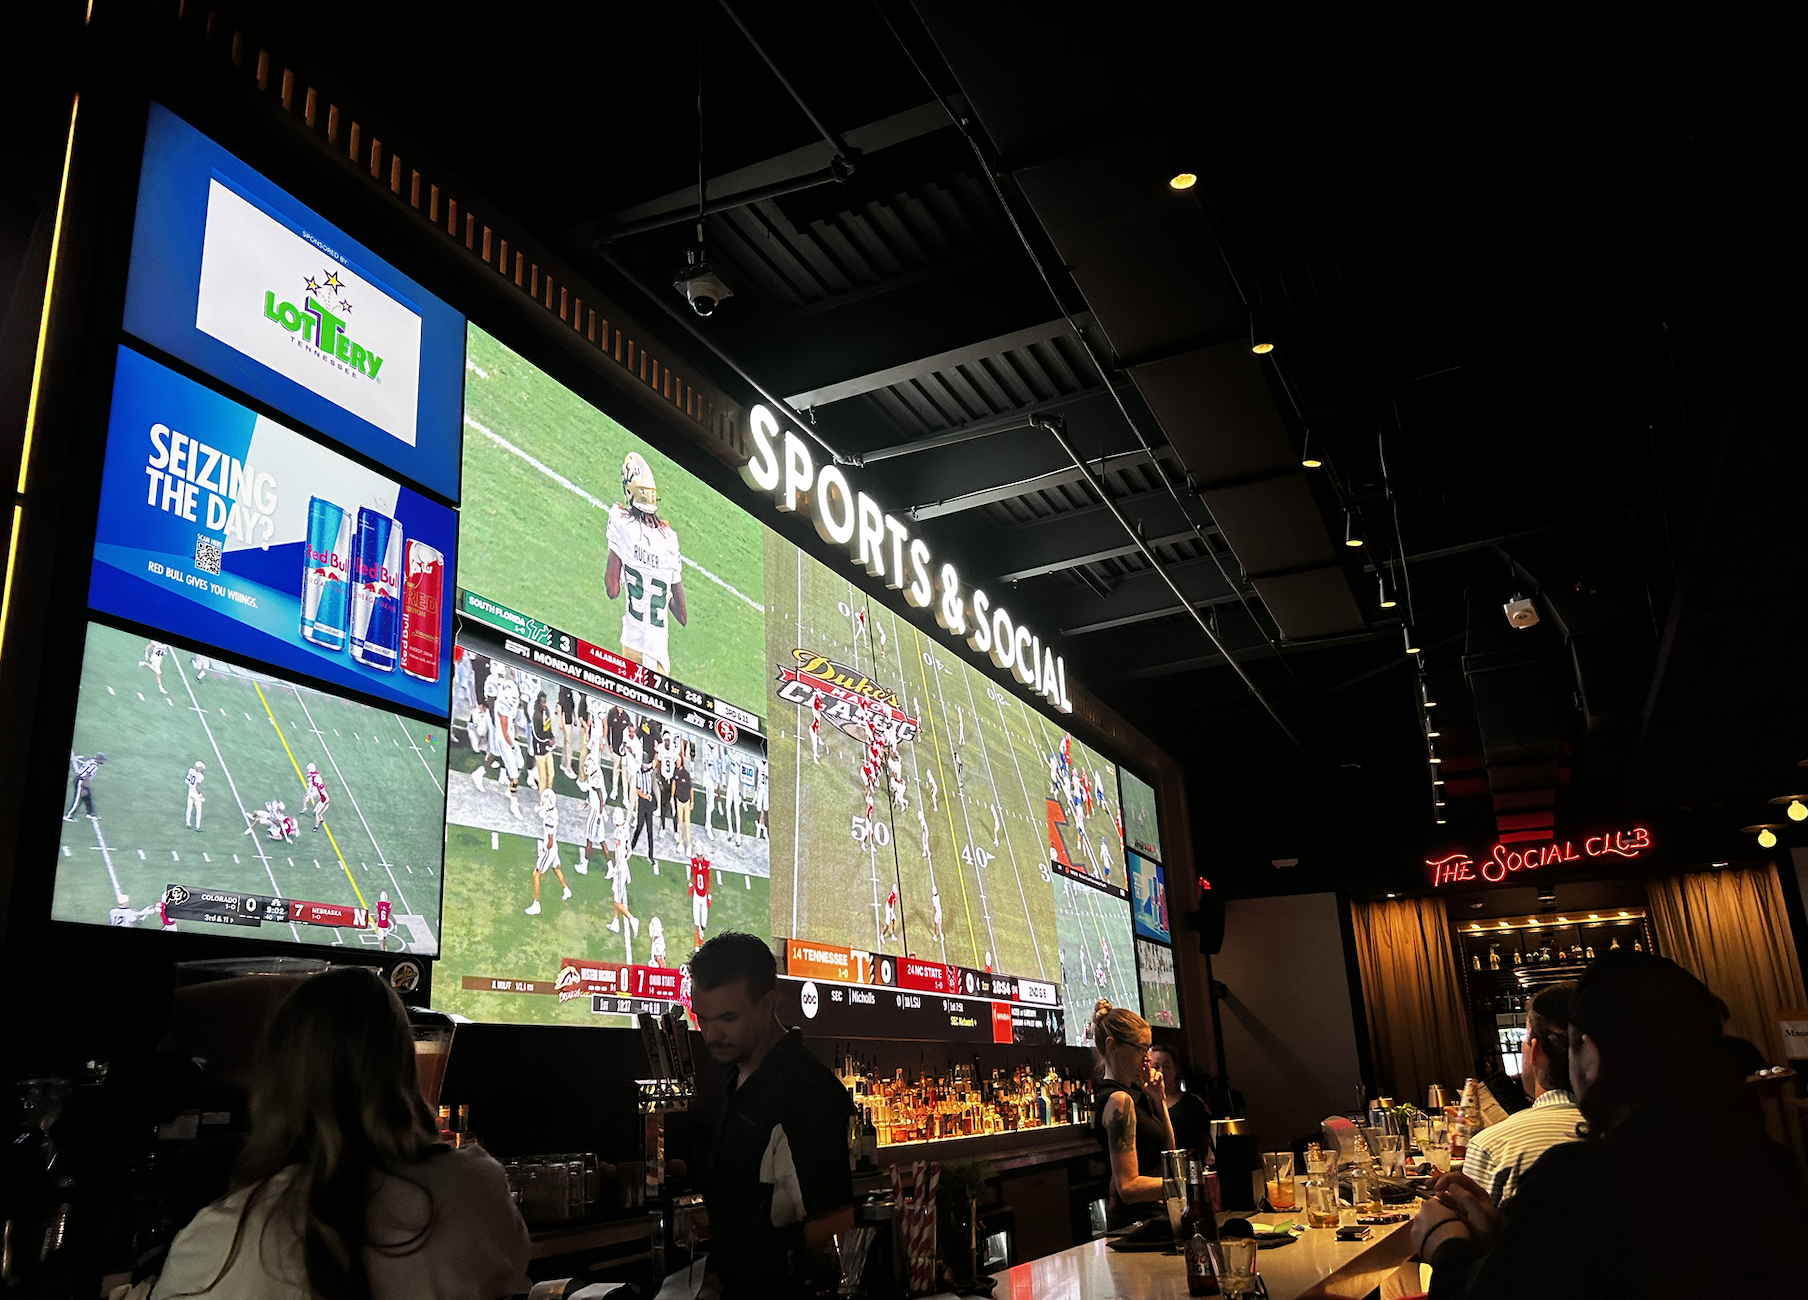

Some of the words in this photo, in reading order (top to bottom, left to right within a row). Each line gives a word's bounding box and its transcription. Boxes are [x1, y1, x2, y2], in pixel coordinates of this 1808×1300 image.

[302, 230, 339, 260] SPONSORED
[264, 290, 383, 380] LOTTERY
[290, 335, 357, 379] TENNESSEE
[149, 423, 278, 516] SEIZING
[146, 466, 200, 523] THE
[206, 492, 276, 552] DAY?
[197, 533, 210, 543] SCAN
[306, 543, 328, 564] Red
[330, 552, 349, 573] Bull
[633, 544, 660, 570] RUCKER
[746, 404, 932, 608] SPORTS
[941, 563, 967, 635] &
[970, 589, 1074, 714] SOCIAL
[148, 560, 164, 575] RED
[165, 567, 184, 583] BULL
[186, 574, 208, 591] GIVES
[210, 582, 226, 597] YOU
[356, 557, 378, 580] Red
[380, 566, 399, 588] Bull
[406, 588, 437, 614] RED
[624, 563, 668, 628] 22
[468, 596, 496, 615] SOUTH
[495, 608, 526, 627] FLORIDA
[560, 635, 571, 652] 3
[595, 649, 627, 669] ALABAMA
[504, 639, 530, 658] ESPN
[533, 650, 583, 678] MONDAY
[583, 670, 616, 692] NIGHT
[616, 683, 667, 712] FOOTBALL
[653, 674, 662, 689] 7
[792, 648, 902, 711] Duke's
[960, 842, 989, 869] 40
[1426, 854, 1476, 887] THE
[1482, 841, 1580, 882] SOCIAL
[1585, 828, 1650, 857] CLUB
[201, 894, 238, 904] COLORADO
[245, 898, 257, 912] 0
[294, 904, 304, 917] 7
[204, 914, 216, 922] 3rd
[312, 907, 342, 917] NEBRASKA
[353, 908, 367, 926] N
[792, 947, 802, 960] 14
[803, 948, 848, 966] TENNESSEE
[850, 949, 870, 984] T
[620, 967, 629, 992] 0
[637, 970, 645, 993] 7
[661, 975, 675, 987] STATE
[880, 960, 892, 984] 0
[907, 964, 915, 975] 24
[923, 966, 943, 980] STATE
[965, 972, 975, 994] 0
[802, 991, 818, 1005] abc
[831, 990, 843, 1002] SEC
[851, 990, 876, 1005] Nicholls
[896, 994, 902, 1007] 0
[942, 999, 948, 1011] 9
[1185, 1246, 1209, 1264] Coo
